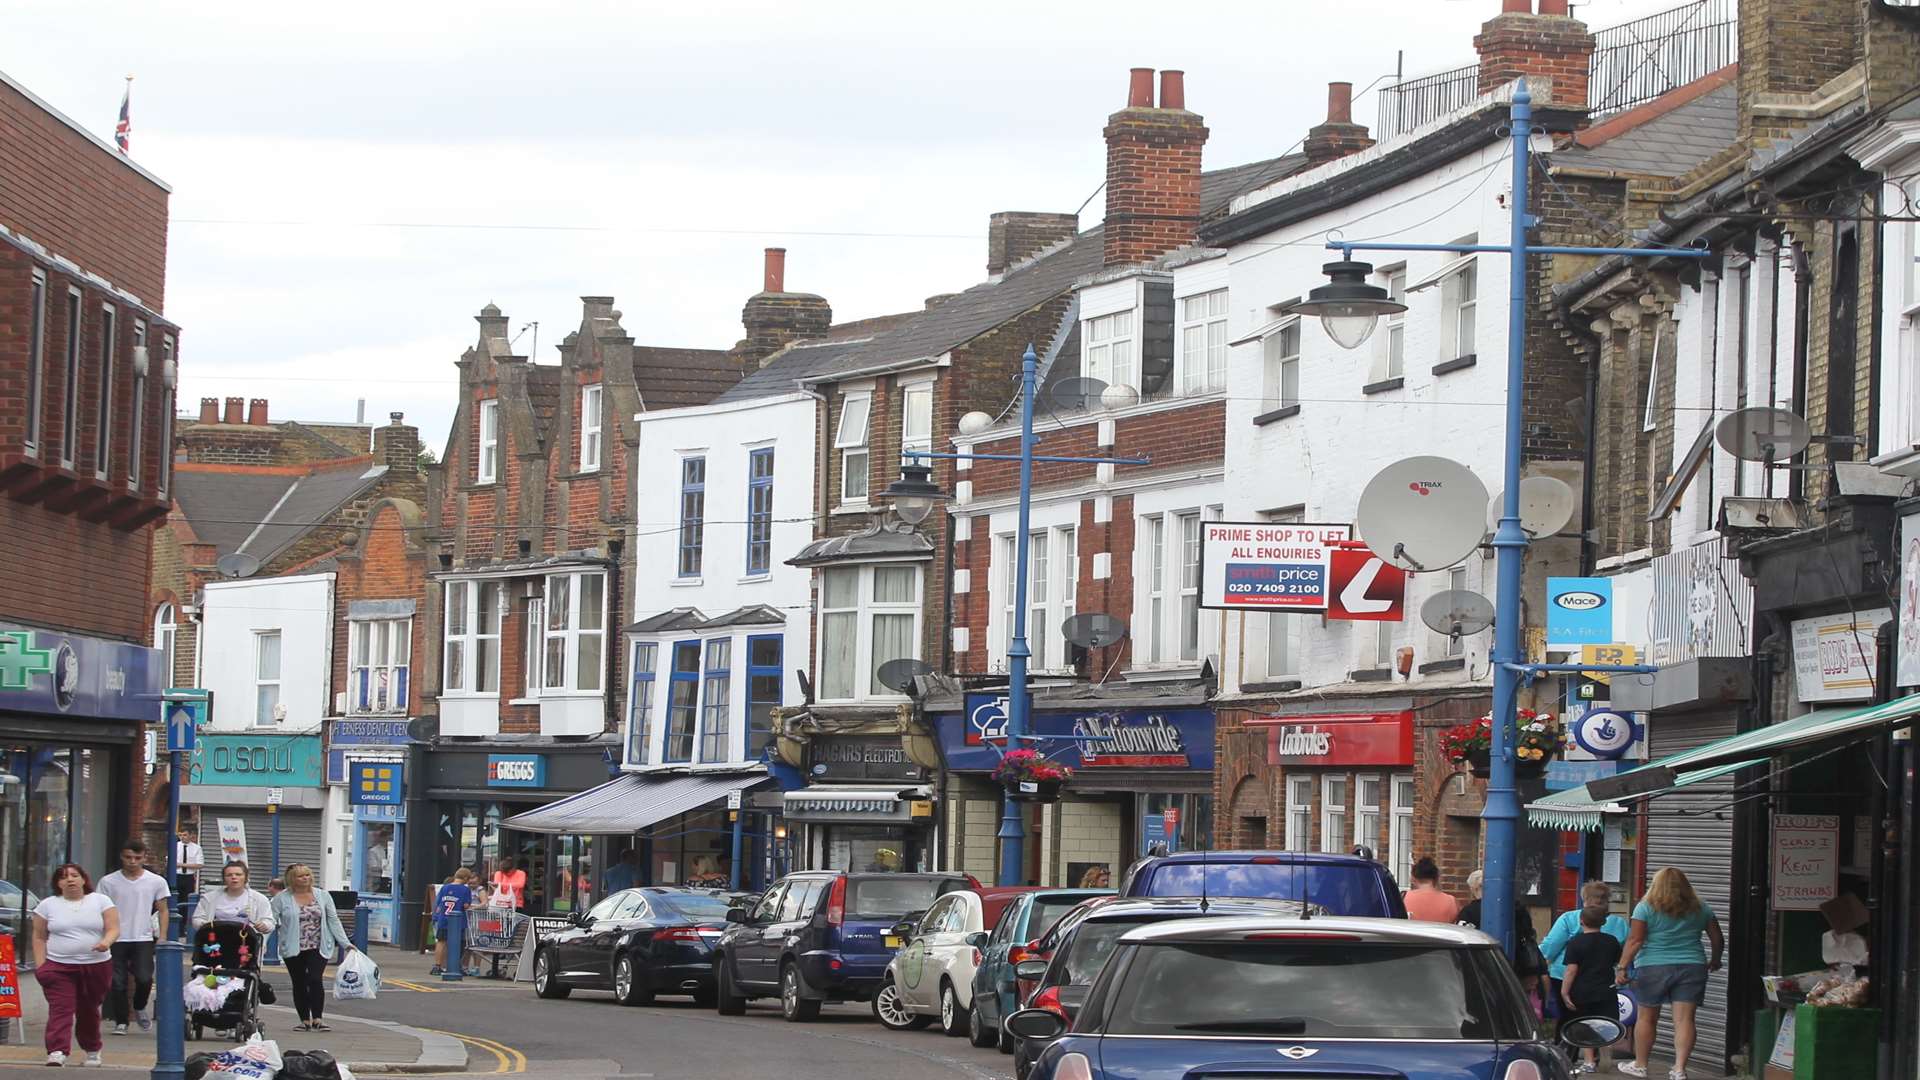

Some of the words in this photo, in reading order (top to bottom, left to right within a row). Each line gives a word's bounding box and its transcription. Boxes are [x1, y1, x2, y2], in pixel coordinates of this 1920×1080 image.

[1209, 528, 1252, 541] PRIME
[1255, 529, 1293, 542] SHOP
[1297, 530, 1315, 543] TO
[1319, 530, 1345, 542] LET
[1231, 547, 1253, 559] ALL
[1256, 547, 1322, 560] ENQUIRIES
[1279, 566, 1319, 582] price
[1228, 583, 1252, 592] 020
[1255, 584, 1286, 593] 7409
[1288, 584, 1320, 594] 2100
[1563, 597, 1597, 606] Mace
[367, 722, 392, 736] DENTAL
[1085, 714, 1182, 753] Nationwide
[1279, 725, 1333, 756] Ladbrokes
[814, 744, 861, 763] HAGARS
[496, 760, 535, 781] GREGGS
[360, 793, 391, 801] GREGGS
[1163, 809, 1177, 823] FREE
[1775, 885, 1833, 897] STRAWBS
[444, 901, 455, 915] 7
